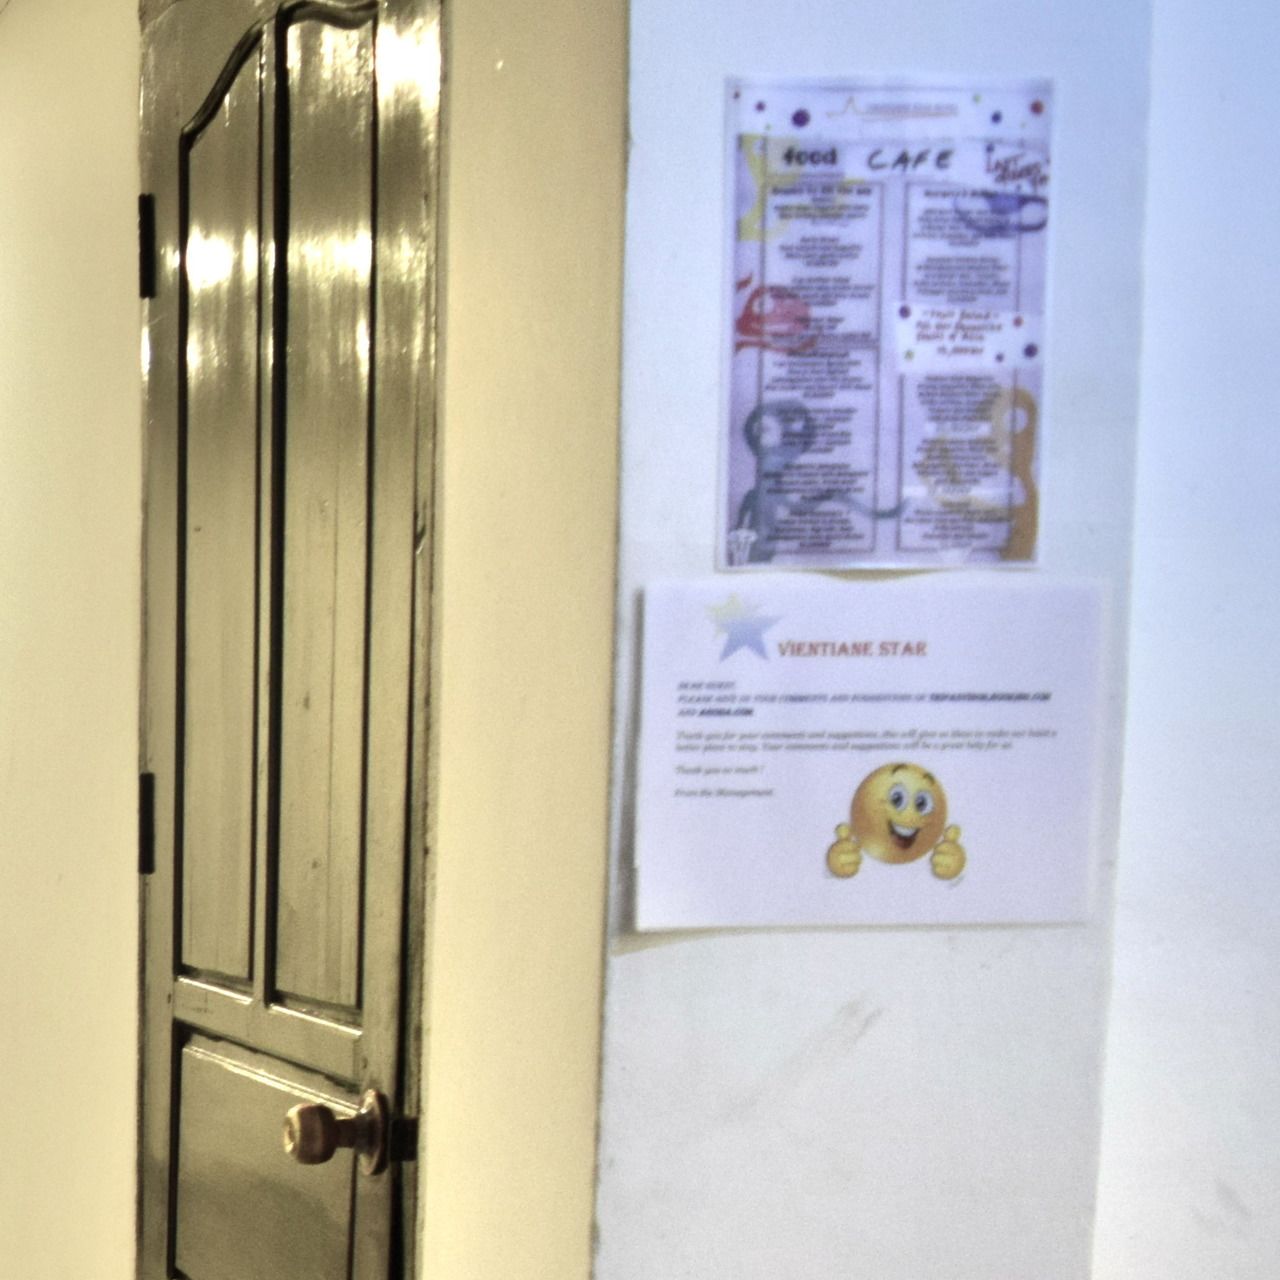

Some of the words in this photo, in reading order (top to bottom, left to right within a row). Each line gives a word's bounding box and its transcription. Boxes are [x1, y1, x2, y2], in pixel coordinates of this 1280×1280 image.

[866, 149, 955, 172] CAFE
[778, 640, 873, 657] VIENTIANE
[878, 640, 928, 657] STAR
